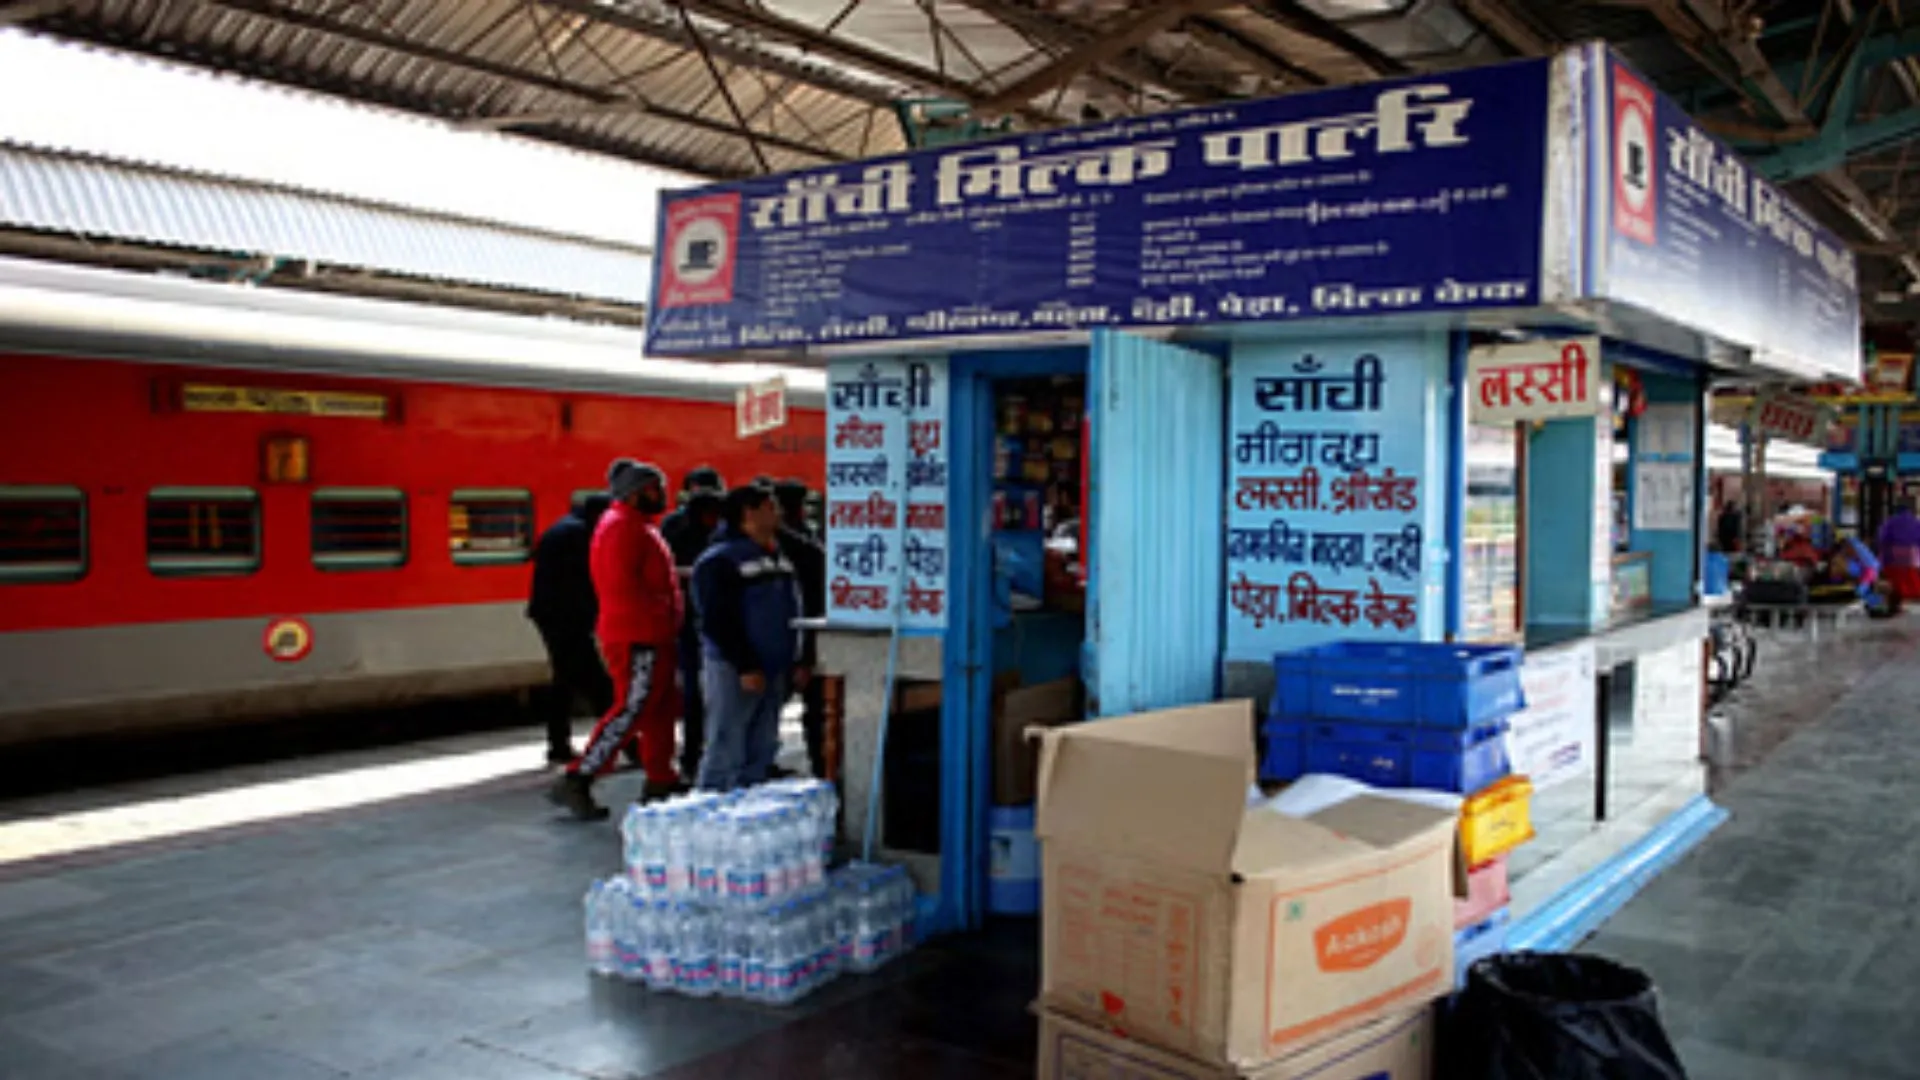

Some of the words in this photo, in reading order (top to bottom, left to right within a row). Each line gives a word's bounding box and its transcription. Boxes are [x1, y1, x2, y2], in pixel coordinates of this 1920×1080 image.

[934, 139, 1177, 206] मिल्क
[1201, 84, 1474, 171] पार्लर
[1254, 353, 1386, 413] साँची
[1477, 340, 1588, 408] लस्सी
[1236, 420, 1316, 466] मीठा
[1319, 432, 1382, 471] दूध
[1288, 571, 1360, 626] मिल्क
[1363, 577, 1417, 632] केक
